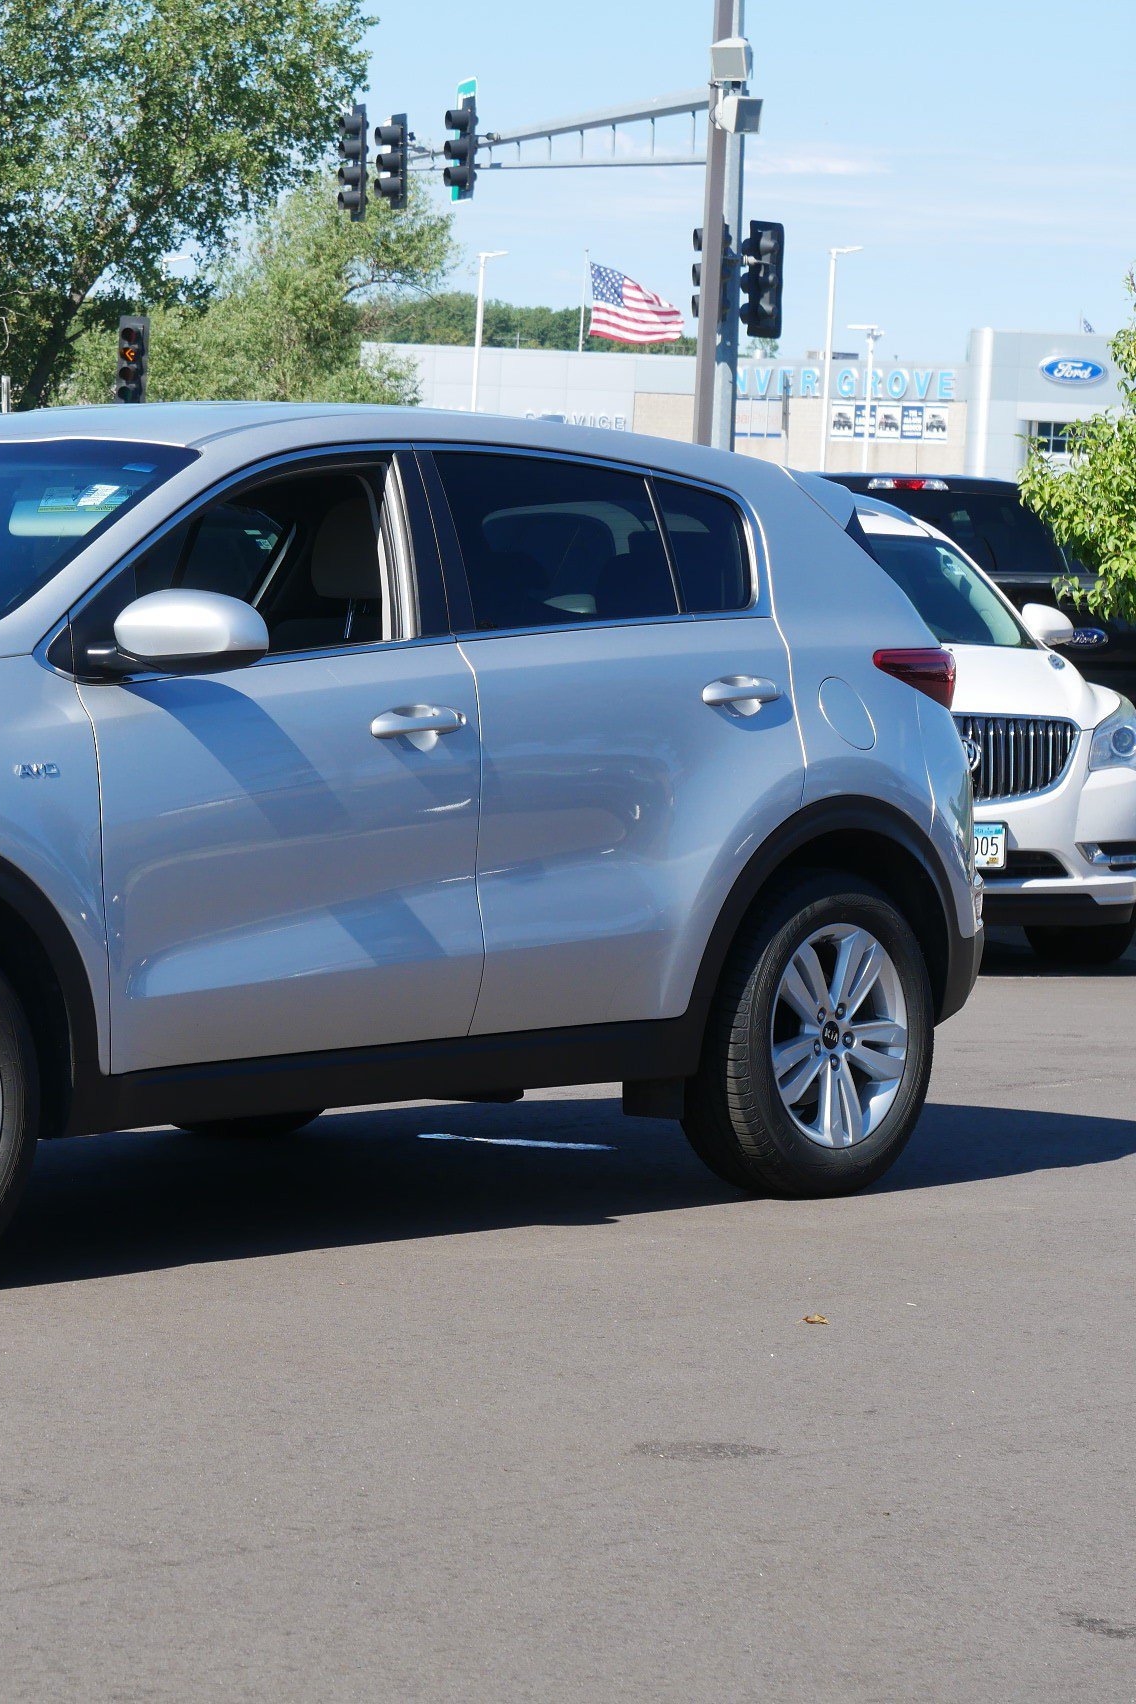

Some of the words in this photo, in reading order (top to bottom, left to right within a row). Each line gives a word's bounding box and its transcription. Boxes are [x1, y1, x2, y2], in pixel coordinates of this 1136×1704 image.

[736, 367, 820, 398] NVER
[837, 368, 954, 399] GROVE
[525, 412, 626, 430] VICE
[14, 763, 58, 777] AWD
